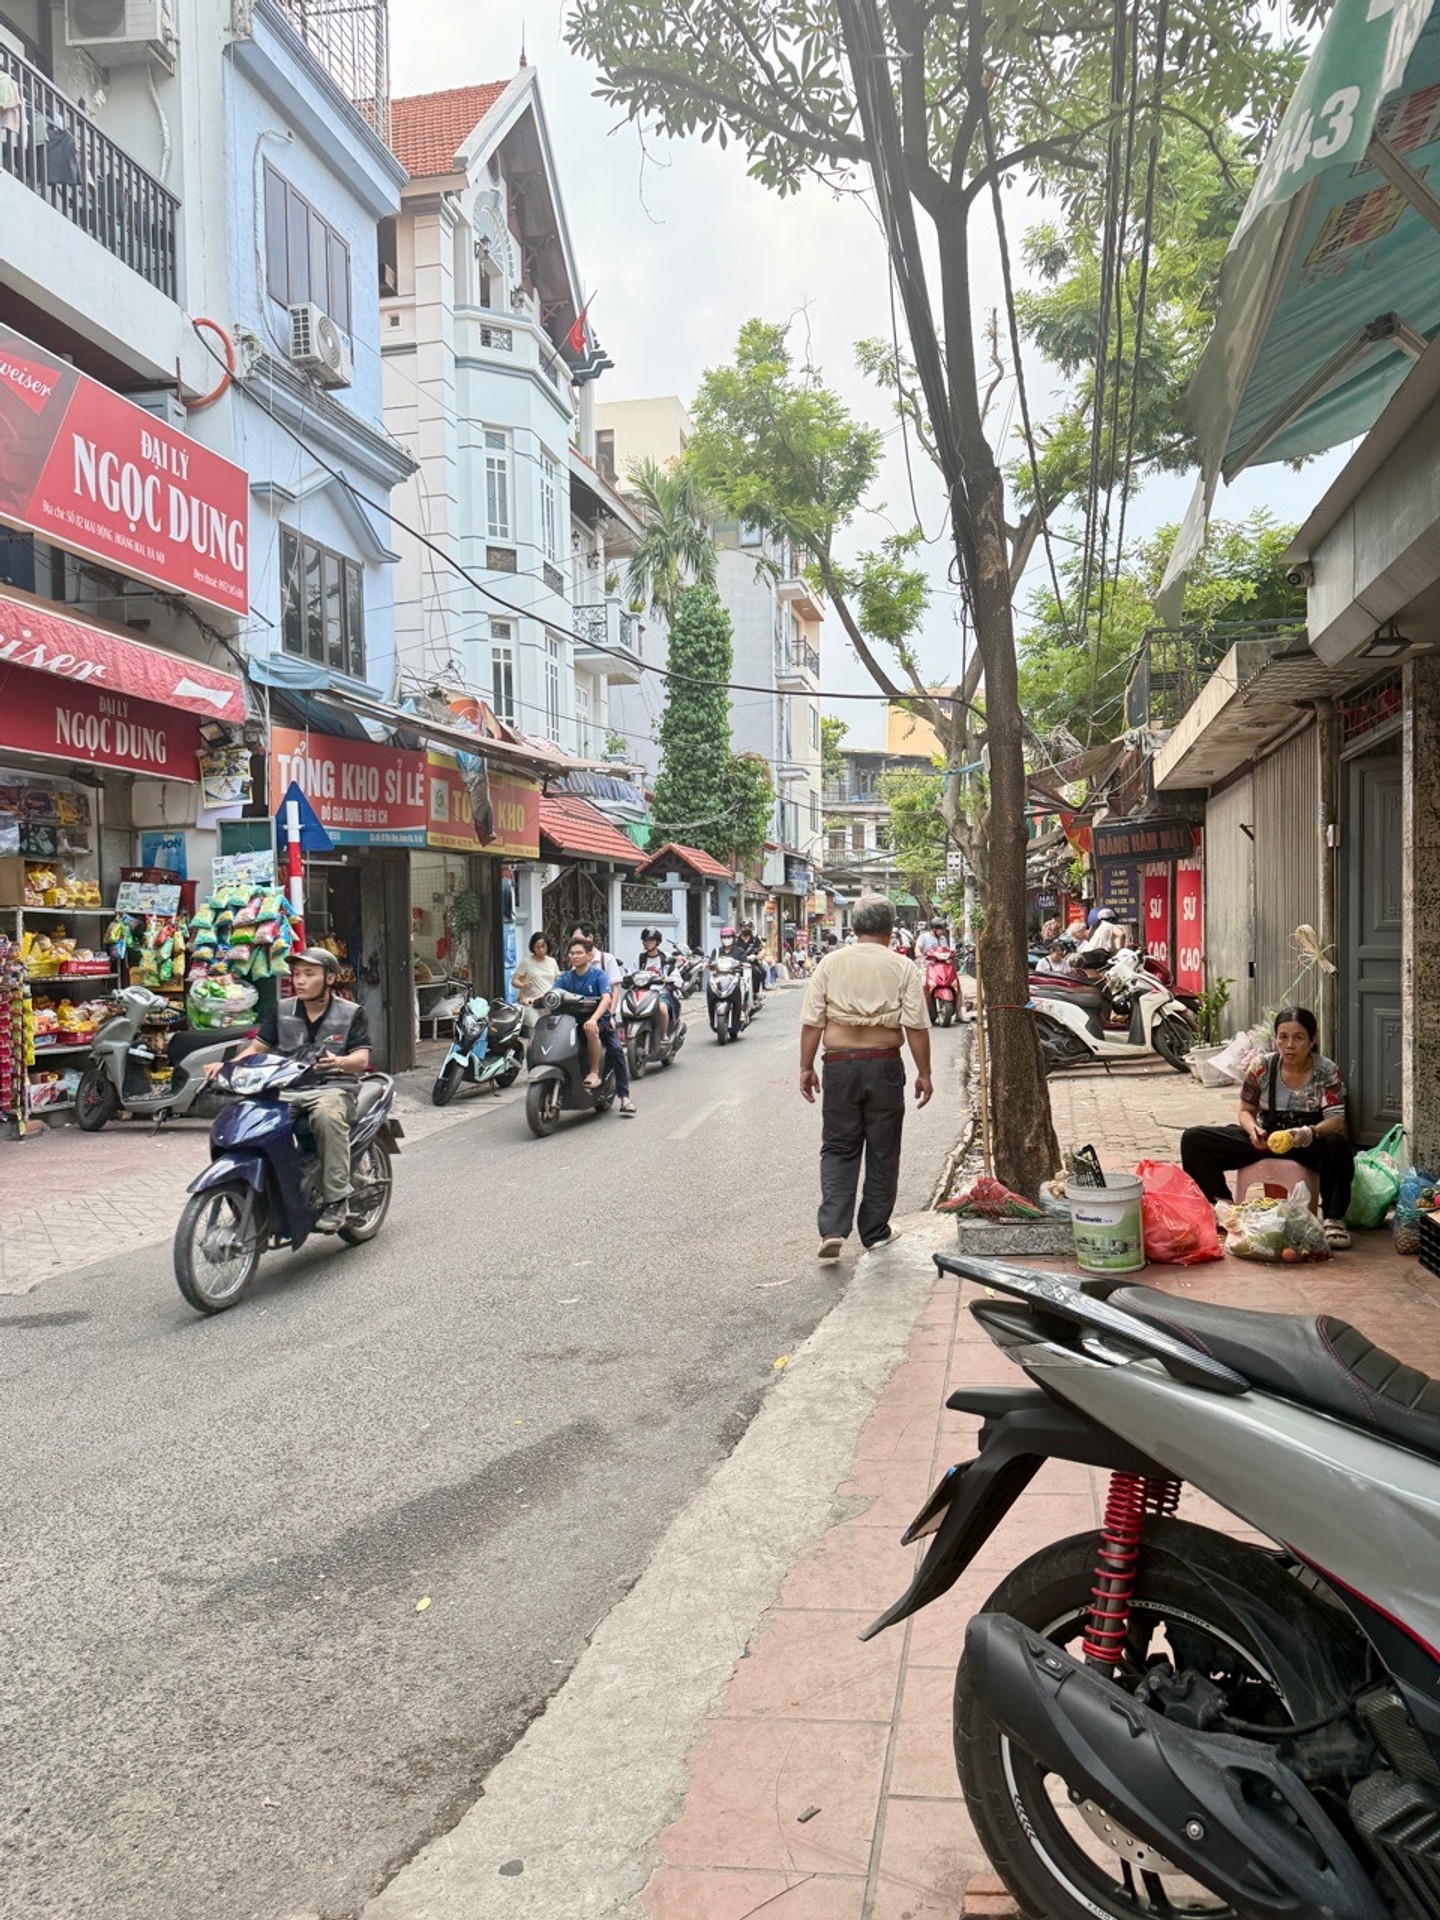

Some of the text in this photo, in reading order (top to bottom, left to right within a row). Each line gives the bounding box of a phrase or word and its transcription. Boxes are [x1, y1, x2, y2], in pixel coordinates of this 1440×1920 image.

[140, 429, 190, 481] ĐẠI LÝ
[72, 432, 245, 572] NGỌC DUNG
[99, 695, 129, 719] ĐẠI LÝ
[56, 707, 167, 765] NGỌC DUNG
[277, 740, 425, 807] TỔNG KHO SỈ LẺ
[332, 806, 343, 821] GIA
[497, 799, 526, 833] KHO
[1148, 941, 1167, 962] CAO
[1180, 947, 1200, 972] CAO
